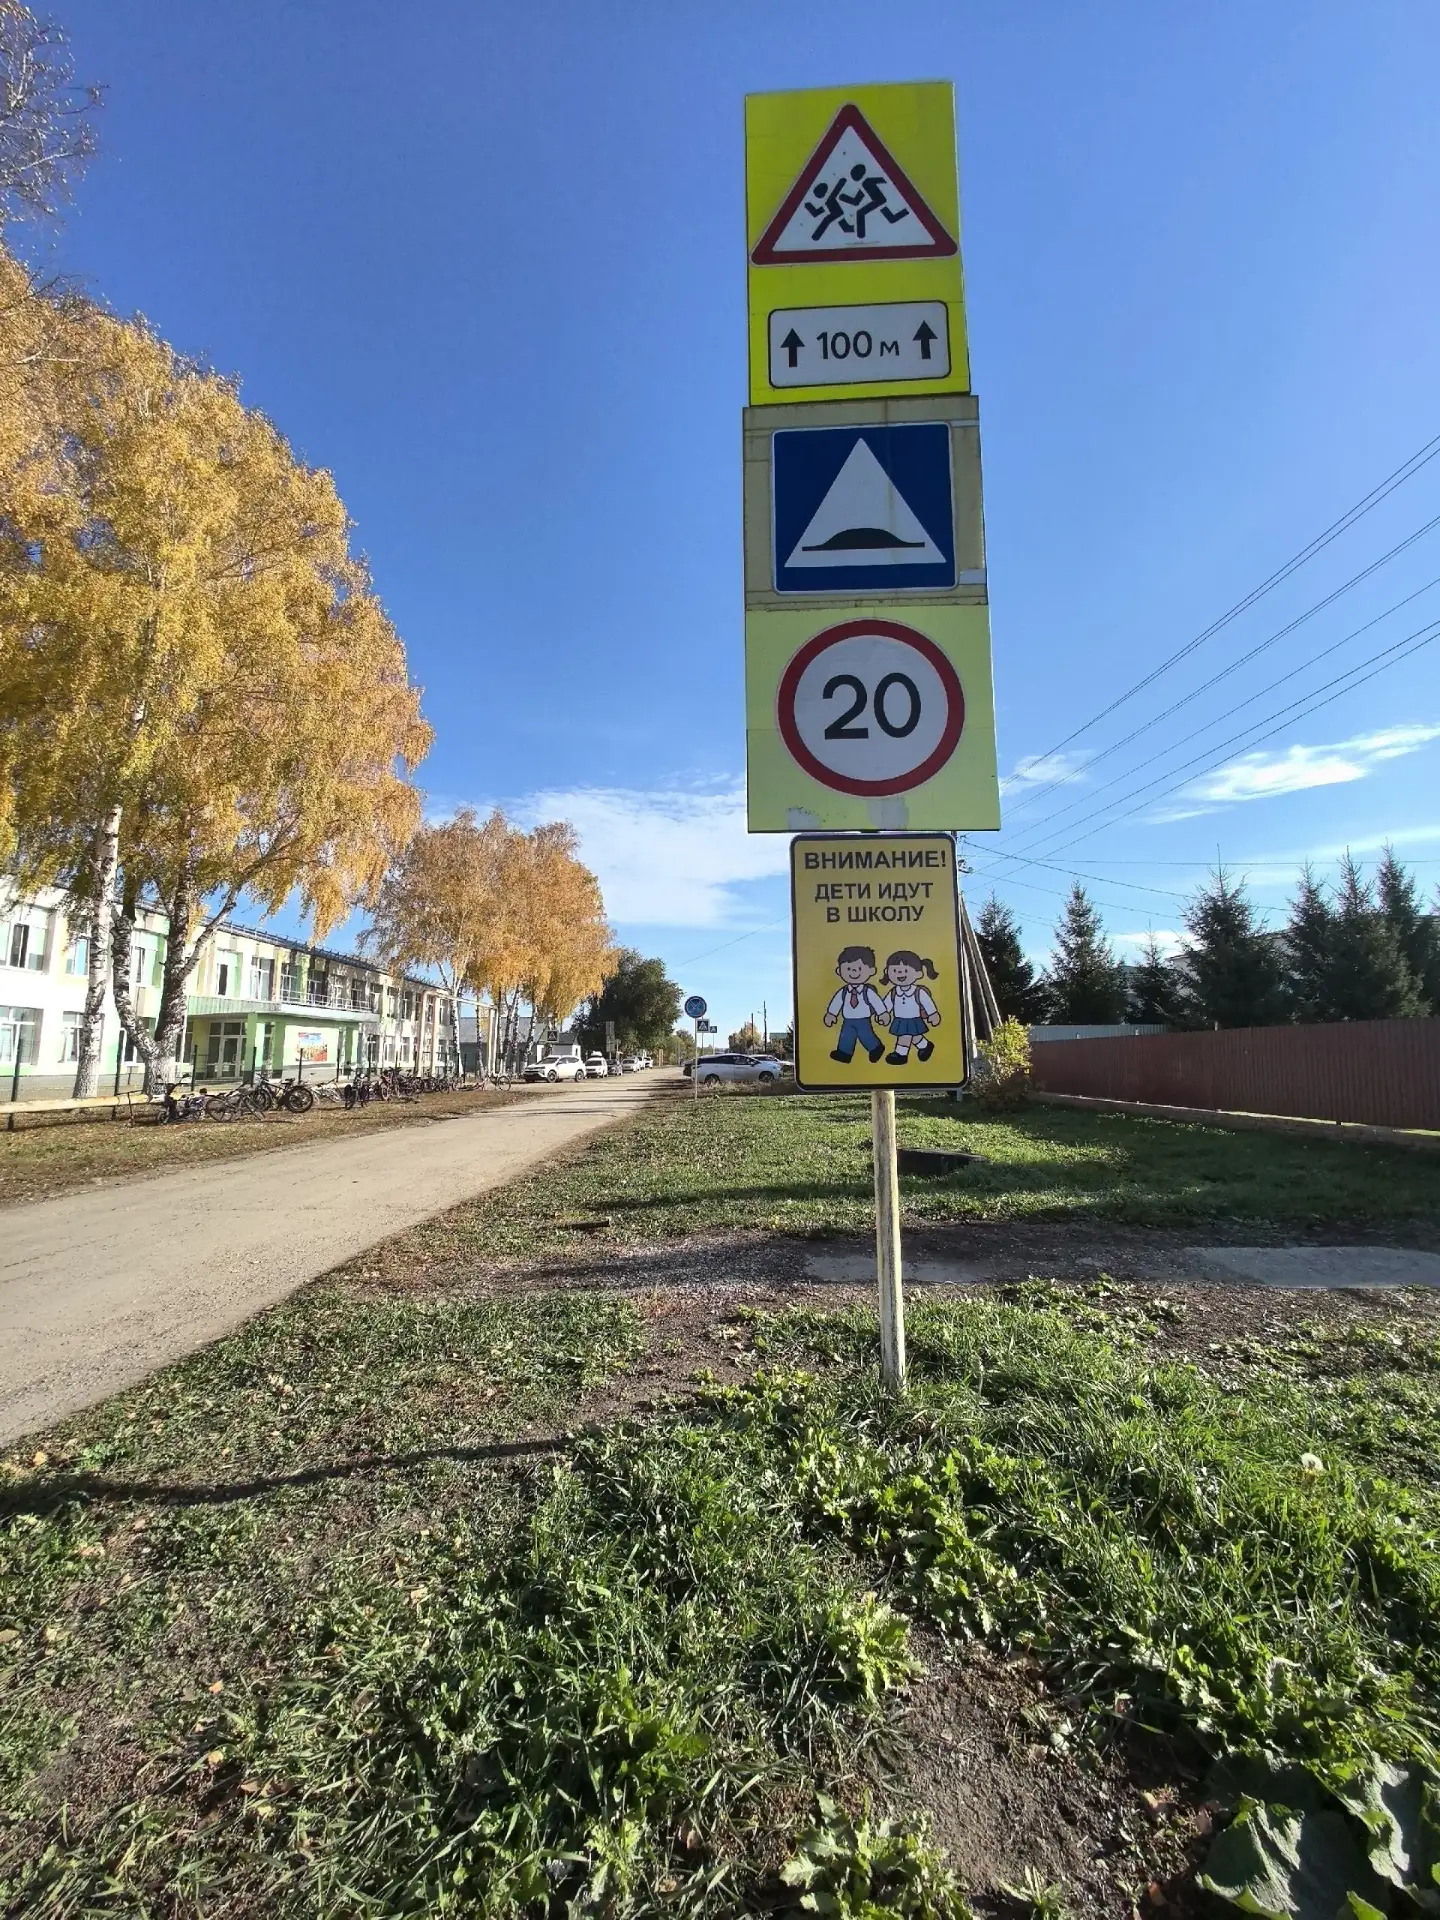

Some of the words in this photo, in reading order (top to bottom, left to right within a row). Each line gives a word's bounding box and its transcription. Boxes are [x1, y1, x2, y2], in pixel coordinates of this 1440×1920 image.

[816, 330, 872, 360] 100
[822, 672, 922, 740] 20
[804, 850, 946, 870] ВНИМАНИЕ!
[814, 883, 871, 902] ДЕТИ
[878, 882, 933, 902] ИДУТ
[826, 906, 840, 923] В
[847, 905, 924, 923] ШКОЛУ
